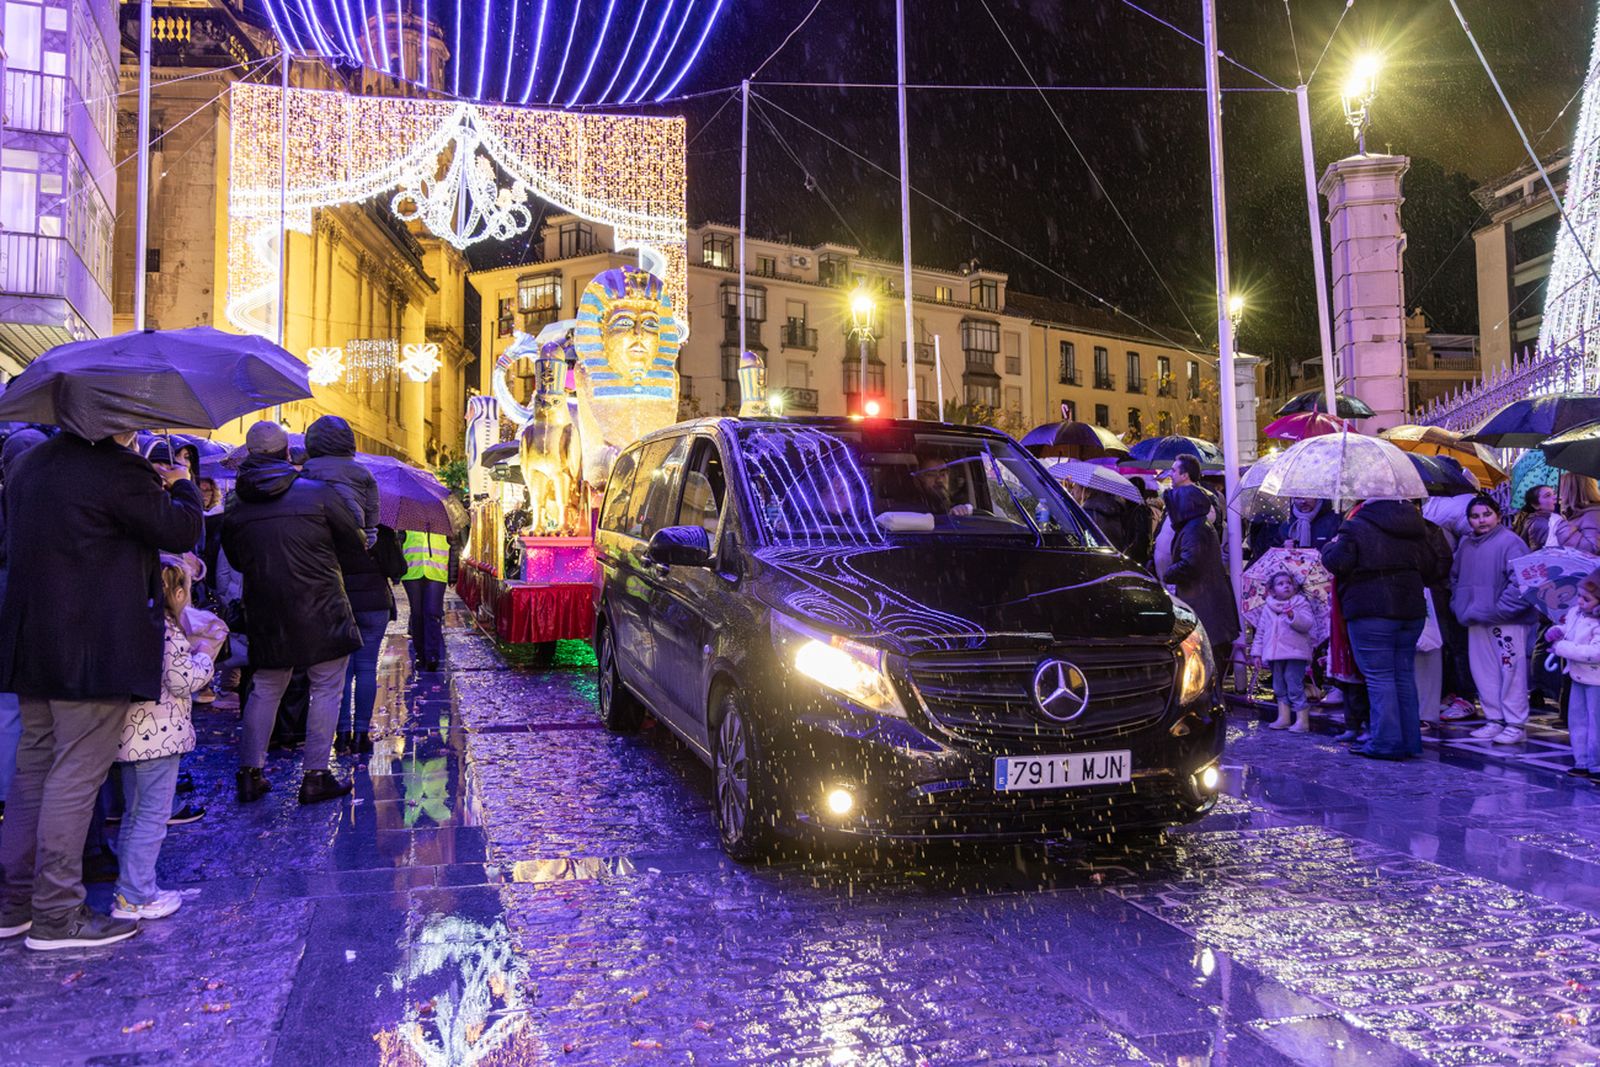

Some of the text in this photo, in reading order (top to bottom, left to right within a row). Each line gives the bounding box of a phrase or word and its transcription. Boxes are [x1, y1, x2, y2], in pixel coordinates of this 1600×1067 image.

[1013, 755, 1123, 785] 7911 MJN
[999, 777, 1005, 785] E
